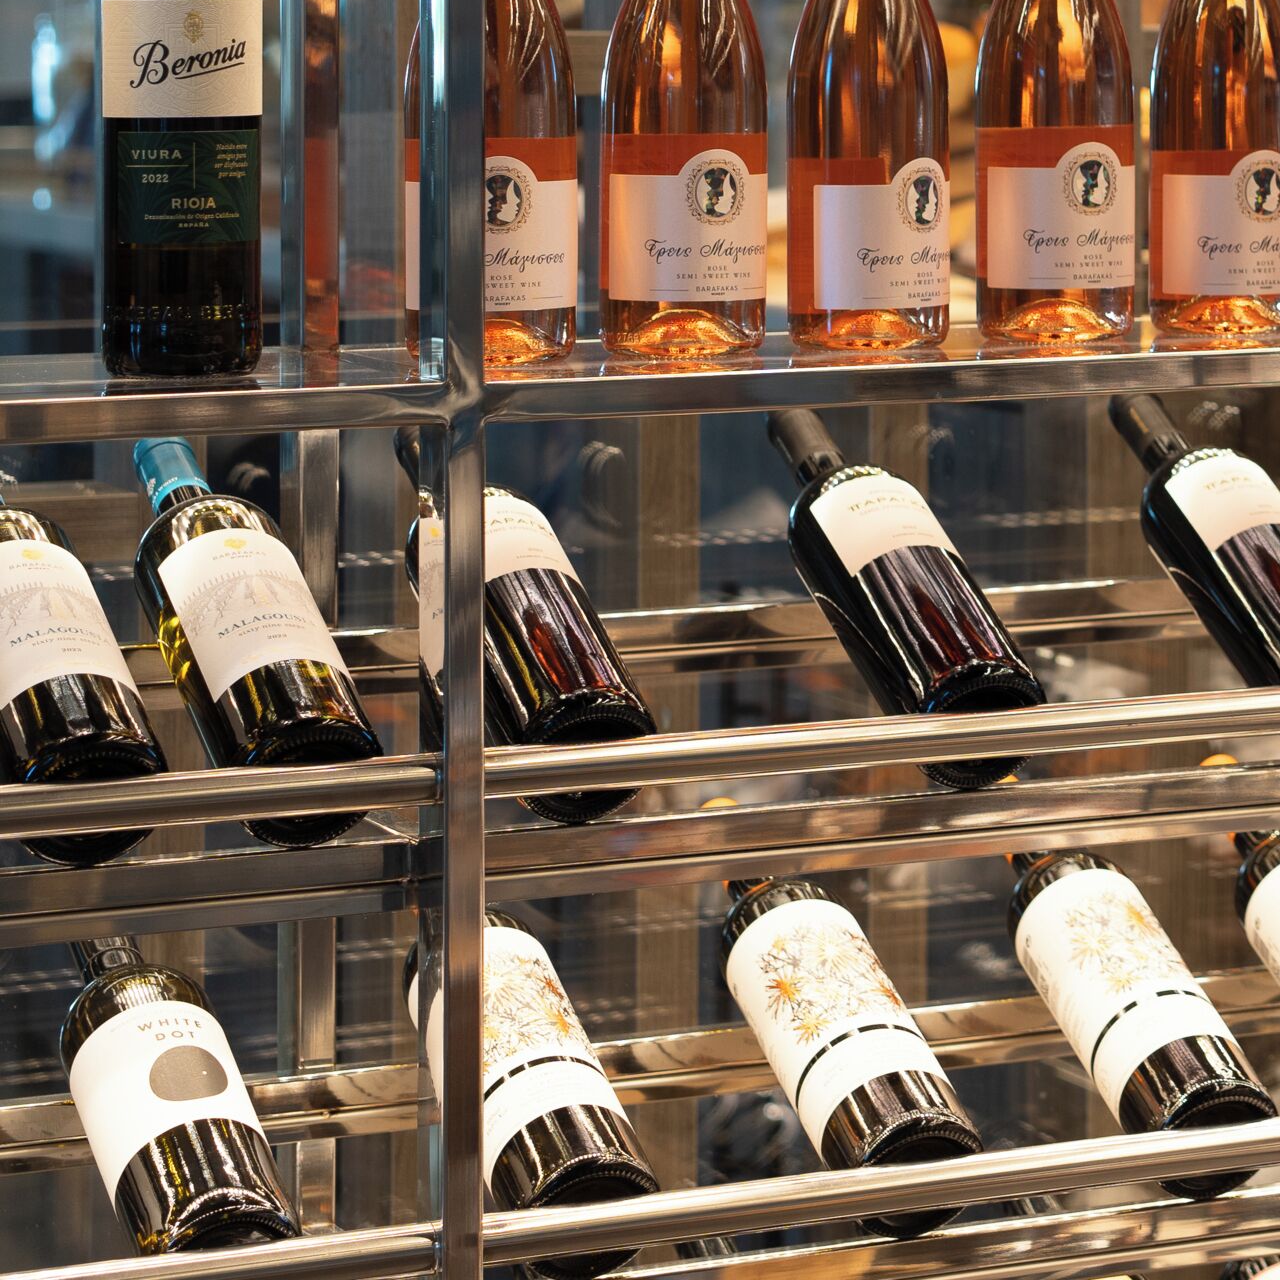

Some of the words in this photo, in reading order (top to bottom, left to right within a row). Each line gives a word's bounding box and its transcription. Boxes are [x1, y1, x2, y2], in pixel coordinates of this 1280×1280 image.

[130, 39, 246, 88] Beronia
[131, 150, 182, 159] VIURA
[141, 174, 169, 183] 2022
[171, 197, 216, 209] RIOJA
[1023, 229, 1069, 254] Τρεις
[1197, 236, 1242, 260] Τρεις
[644, 239, 692, 264] Τρεις
[857, 248, 904, 273] Τρεις
[137, 1018, 202, 1031] WHITE
[155, 1030, 194, 1041] DOT
